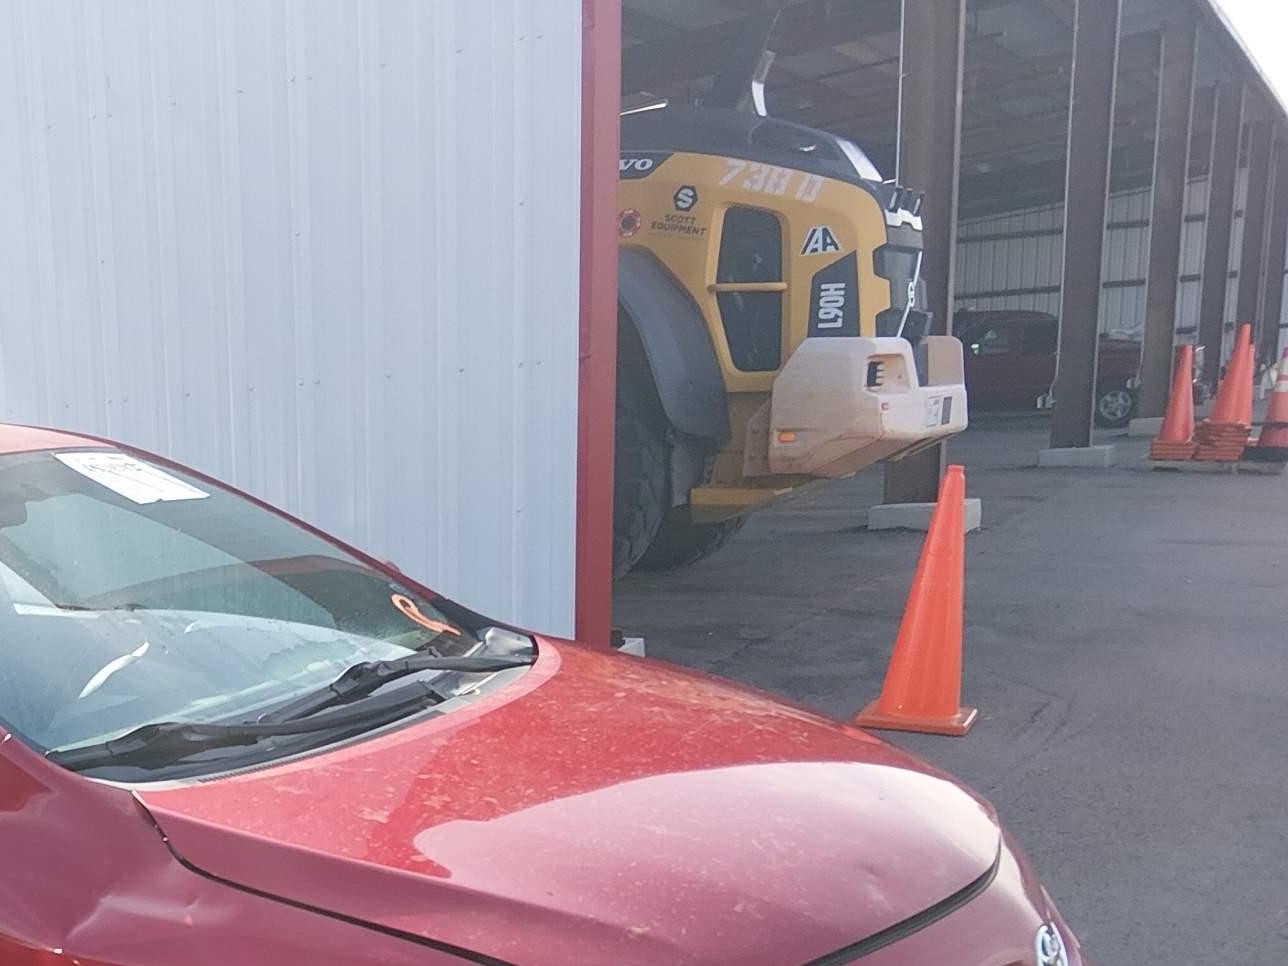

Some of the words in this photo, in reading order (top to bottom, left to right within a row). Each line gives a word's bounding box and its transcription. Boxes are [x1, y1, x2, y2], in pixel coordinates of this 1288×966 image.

[664, 214, 697, 225] SCOTT
[650, 220, 708, 236] EQUIPMENT
[817, 282, 846, 329] L90H
